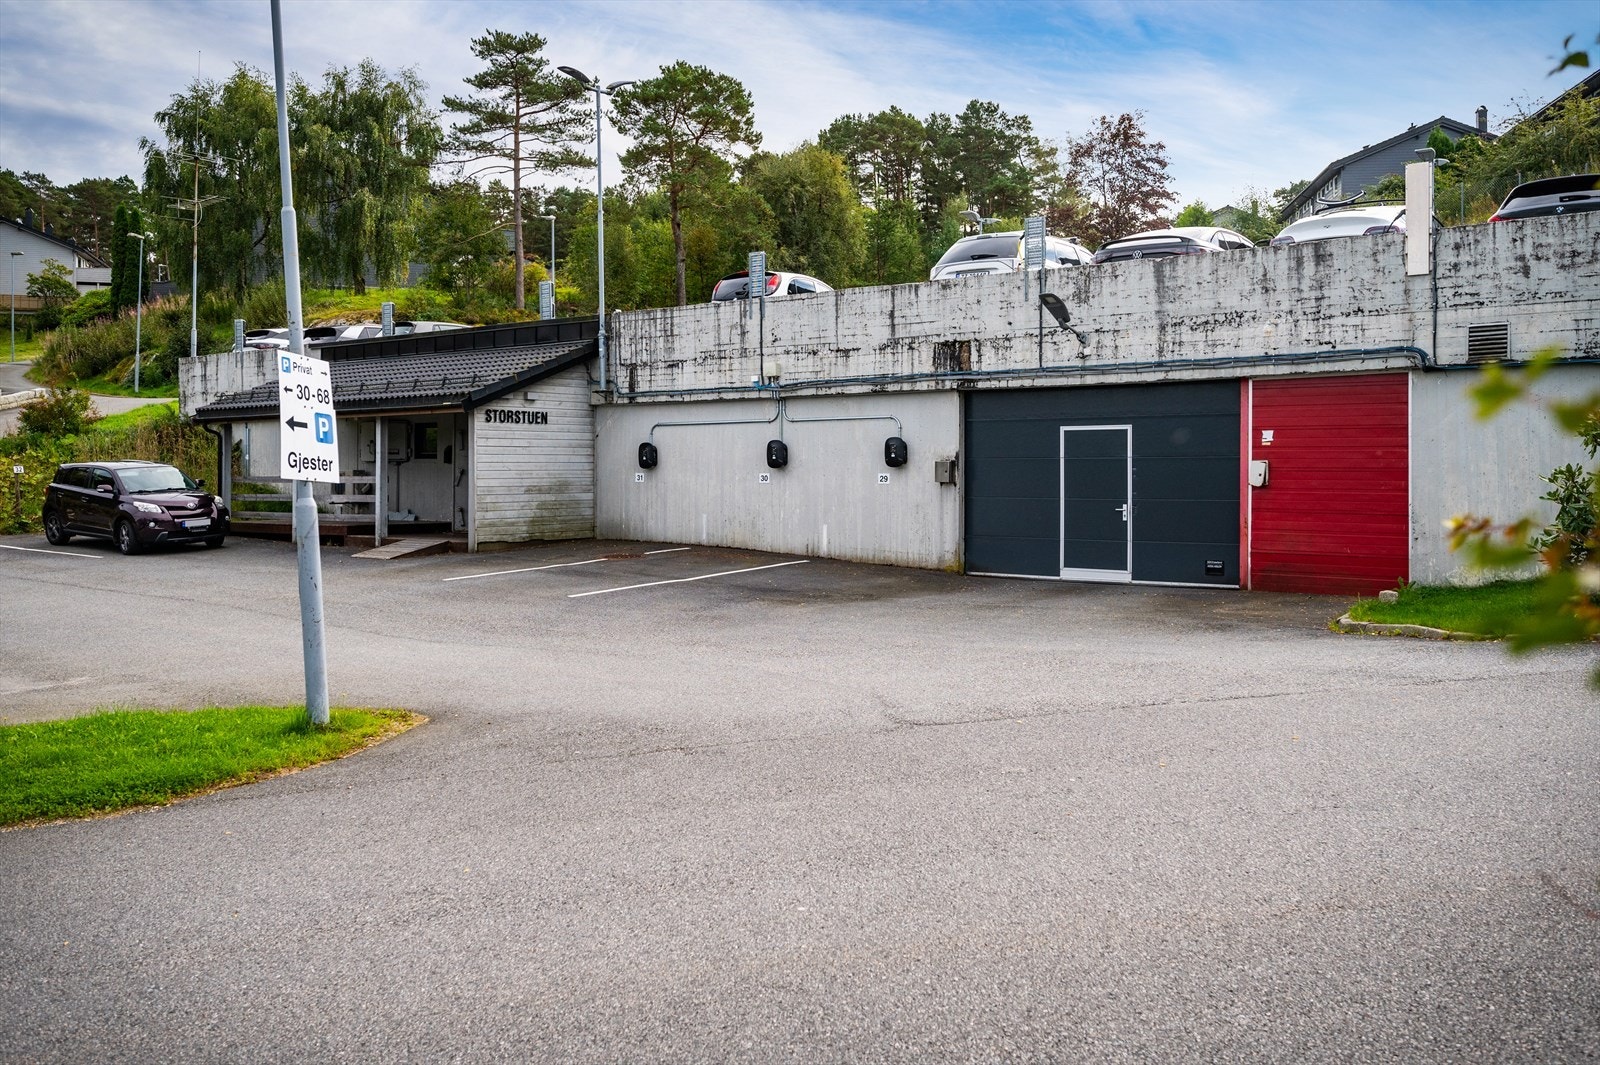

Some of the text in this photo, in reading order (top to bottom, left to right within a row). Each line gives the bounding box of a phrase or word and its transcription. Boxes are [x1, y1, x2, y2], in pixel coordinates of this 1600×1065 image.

[292, 361, 312, 375] Privat
[485, 408, 548, 425] STORSTUEN
[318, 417, 329, 439] P
[288, 451, 333, 473] Gjester
[760, 474, 769, 482] 30
[879, 475, 889, 483] 29
